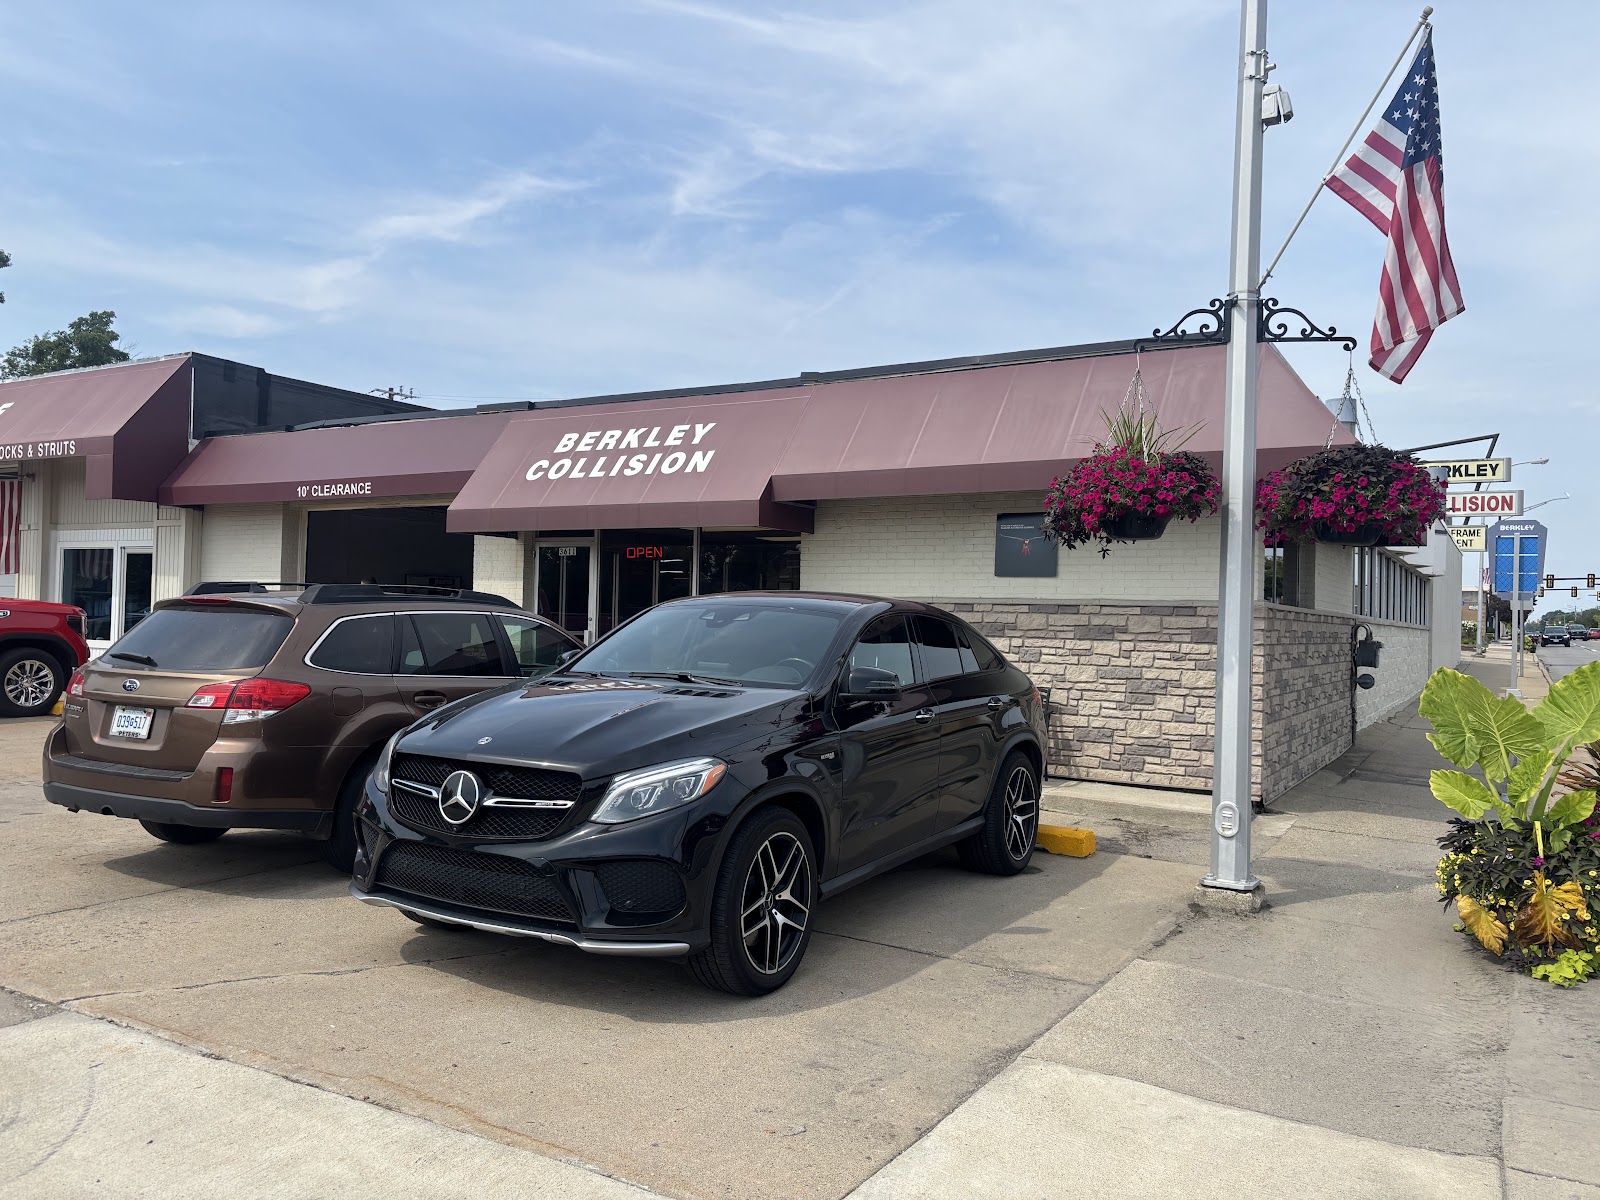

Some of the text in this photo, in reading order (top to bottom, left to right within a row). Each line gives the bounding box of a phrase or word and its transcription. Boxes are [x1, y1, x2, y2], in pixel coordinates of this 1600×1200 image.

[553, 422, 717, 453] BERKLEY
[27, 443, 34, 458] &
[37, 440, 76, 457] STRUTS
[525, 450, 716, 481] COLLISION
[1440, 463, 1500, 478] RKLEY
[297, 482, 372, 498] 10' CLEARANCE
[1447, 495, 1514, 512] LISION
[1451, 529, 1482, 537] FRAME
[559, 548, 576, 556] 3611
[626, 546, 663, 559] OPEN
[116, 714, 147, 730] 039G517
